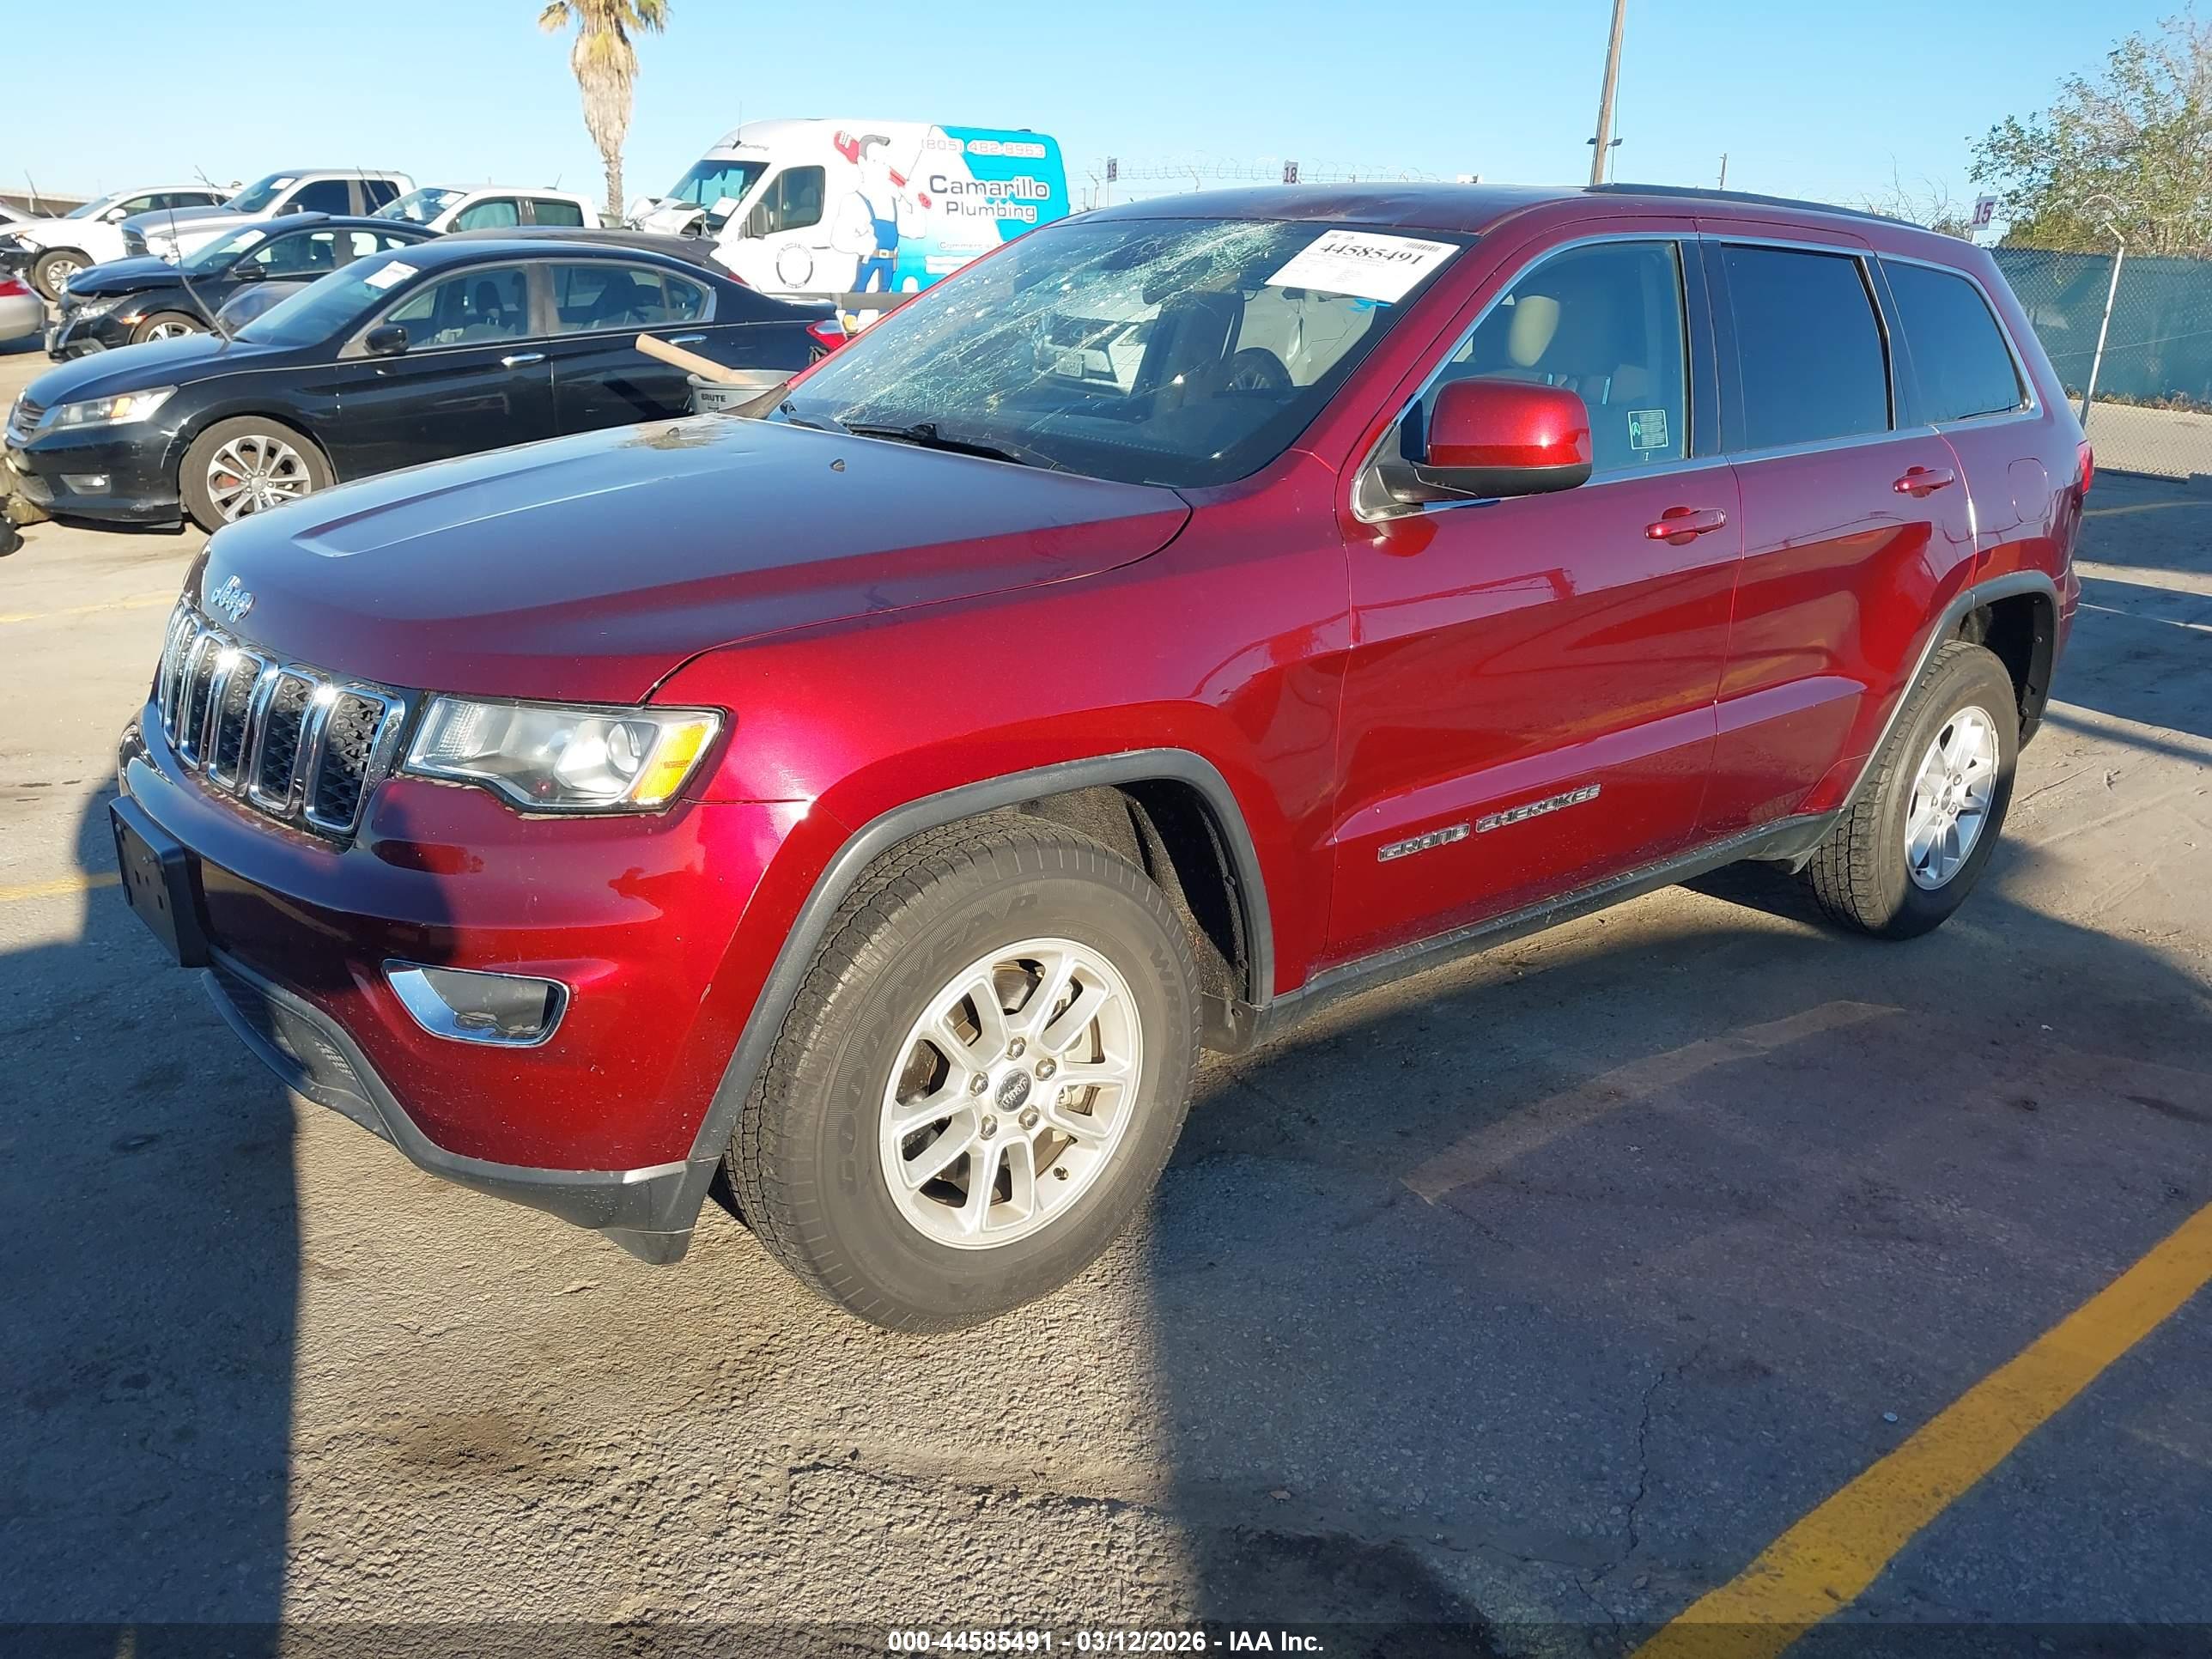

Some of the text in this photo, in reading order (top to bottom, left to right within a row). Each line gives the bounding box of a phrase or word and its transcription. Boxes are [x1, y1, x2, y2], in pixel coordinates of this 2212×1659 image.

[1107, 162, 1117, 179] 19
[1283, 167, 1297, 184] 18
[929, 174, 1048, 198] Camarillo
[945, 200, 1035, 221] Plumbing
[1972, 201, 1994, 225] 15
[1320, 243, 1425, 264] 44585491
[701, 393, 727, 403] BRUTE
[210, 574, 255, 623] Jeep
[1377, 783, 1601, 862] GRAND CHEROKEE
